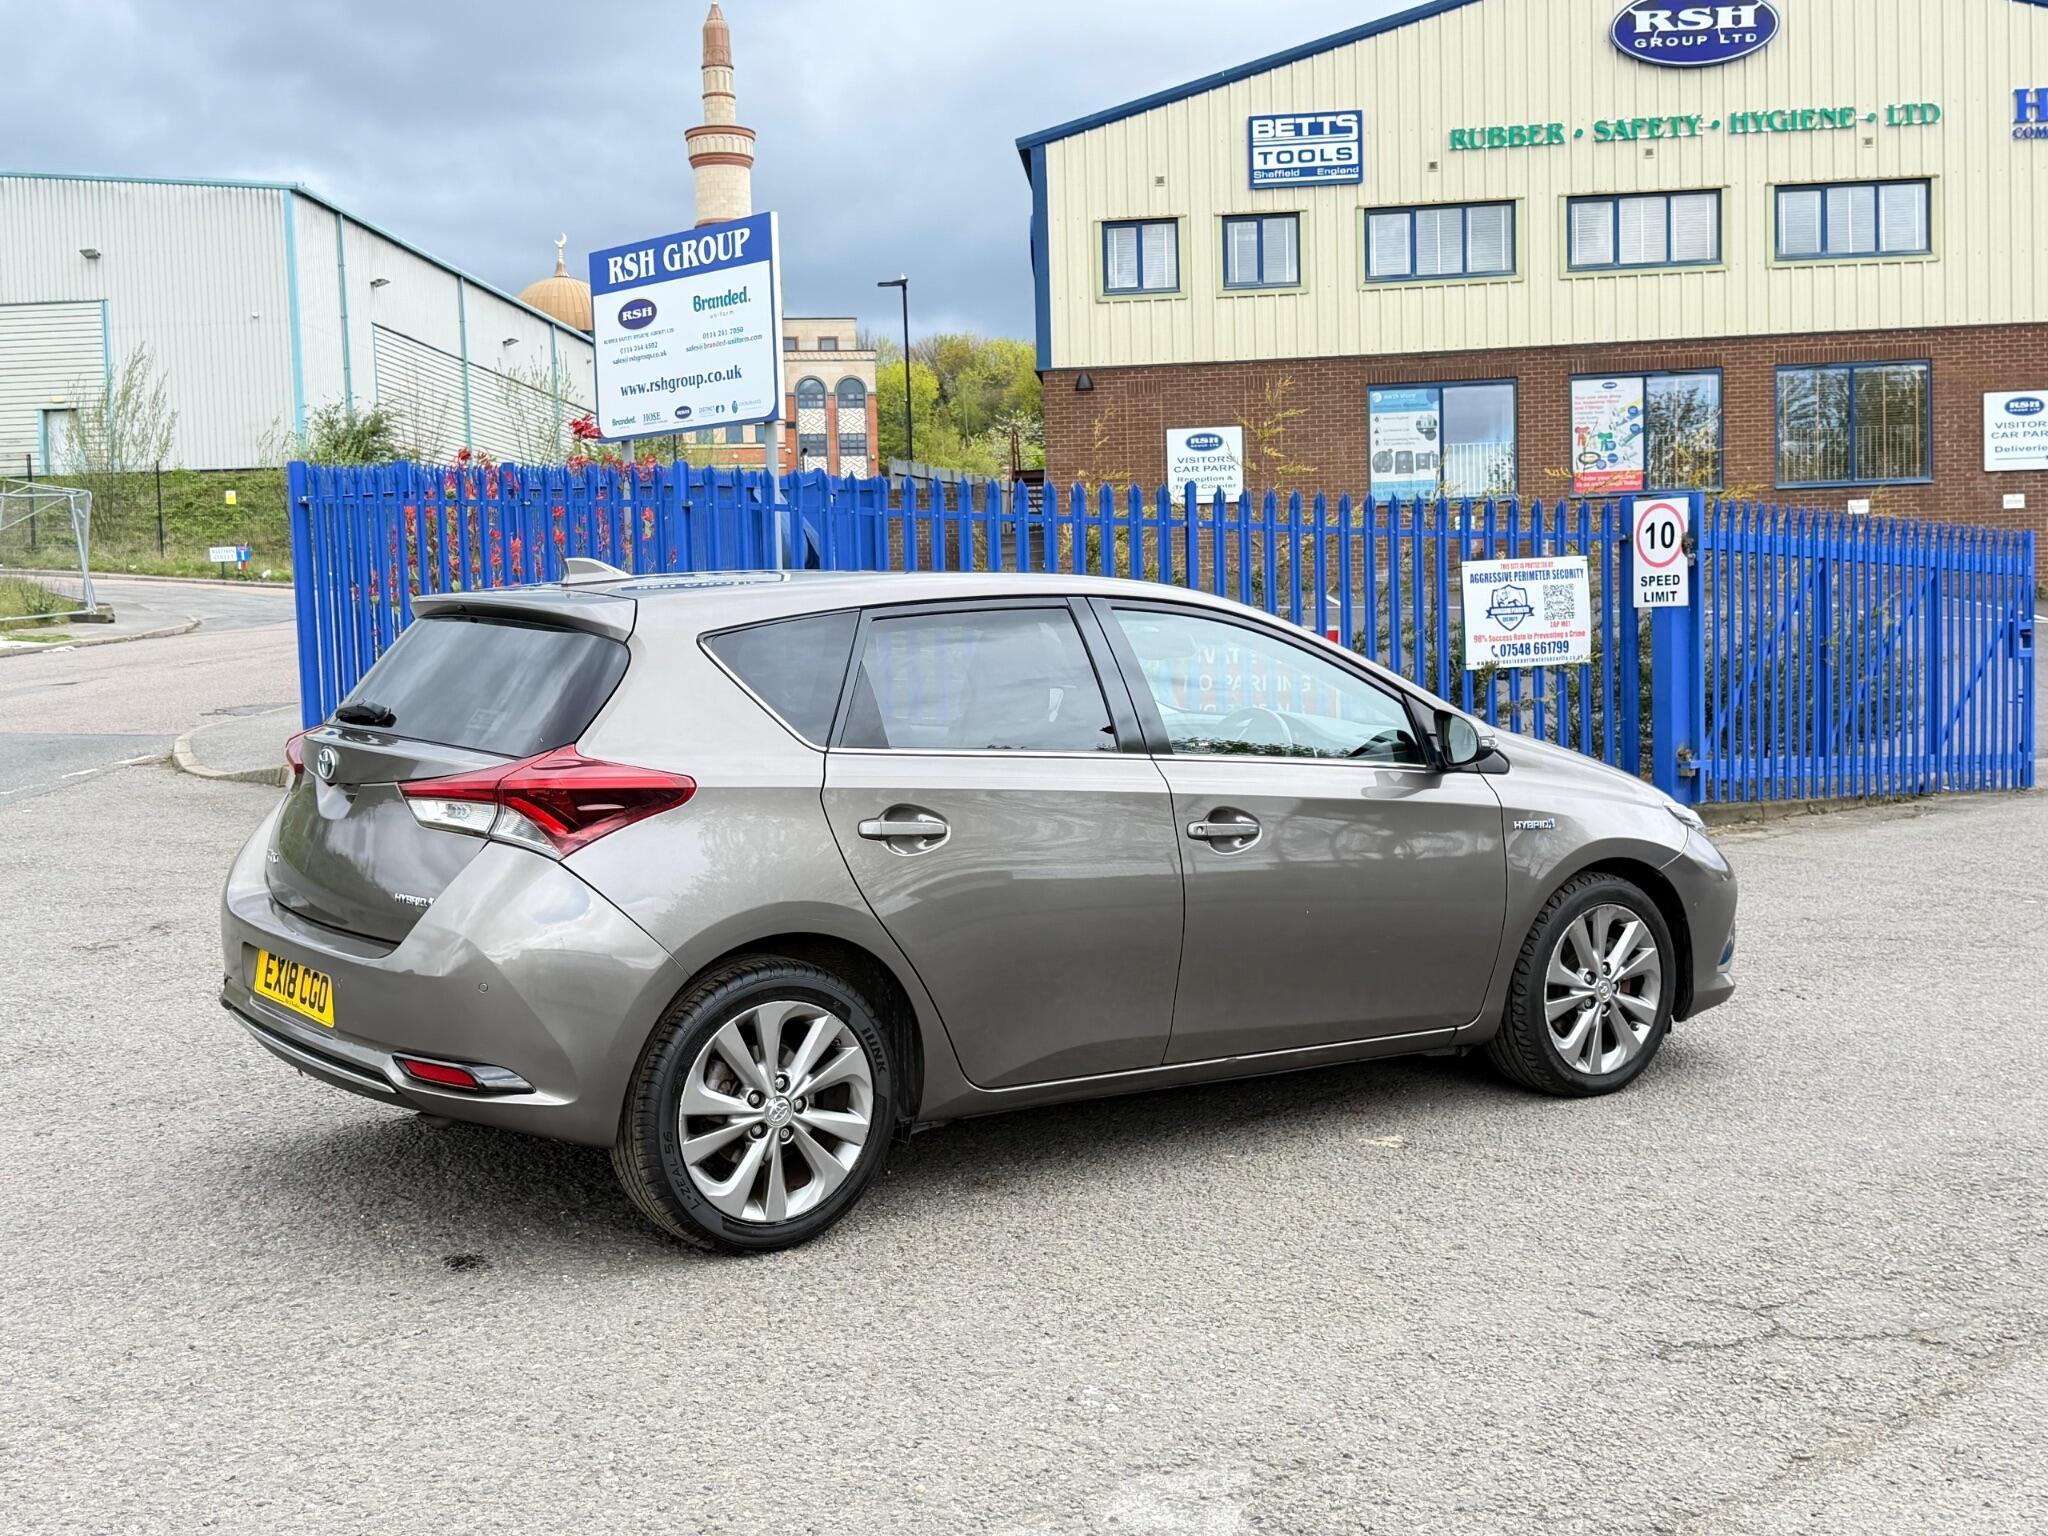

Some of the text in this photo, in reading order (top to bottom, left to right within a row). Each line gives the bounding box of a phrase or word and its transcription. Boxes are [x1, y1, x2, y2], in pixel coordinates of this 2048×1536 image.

[1634, 5, 1757, 33] RSH
[1634, 33, 1757, 48] GROUP LTD
[1252, 114, 1359, 140] BETTS
[1449, 102, 1942, 151] RUBBER SAFETY HYGIENE LTD
[1258, 147, 1353, 166] TOOLS
[1253, 166, 1360, 180] Sheffield England
[608, 227, 751, 285] RSH GROUP
[693, 286, 752, 312] Branded.
[622, 306, 653, 322] RSH
[620, 365, 743, 396] www.rshgroup.co.uk
[1177, 456, 1234, 464] VISITORS
[1174, 464, 1237, 473] CAR PARK
[1177, 475, 1225, 483] Reception
[1645, 521, 1675, 550] 10
[1470, 568, 1584, 584] AGGRESSIVE PERIMETER SECURITY
[1640, 575, 1680, 587] SPEED
[1643, 591, 1678, 603] LIMIT
[1473, 634, 1487, 643] 98%
[1488, 634, 1512, 642] Success
[1534, 632, 1564, 641] Preventing
[1569, 630, 1586, 638] Crime
[1500, 640, 1570, 657] 07548 661799
[1513, 820, 1549, 829] HYBRID
[394, 892, 428, 907] HYBRID
[264, 952, 329, 1013] EX18 CGO
